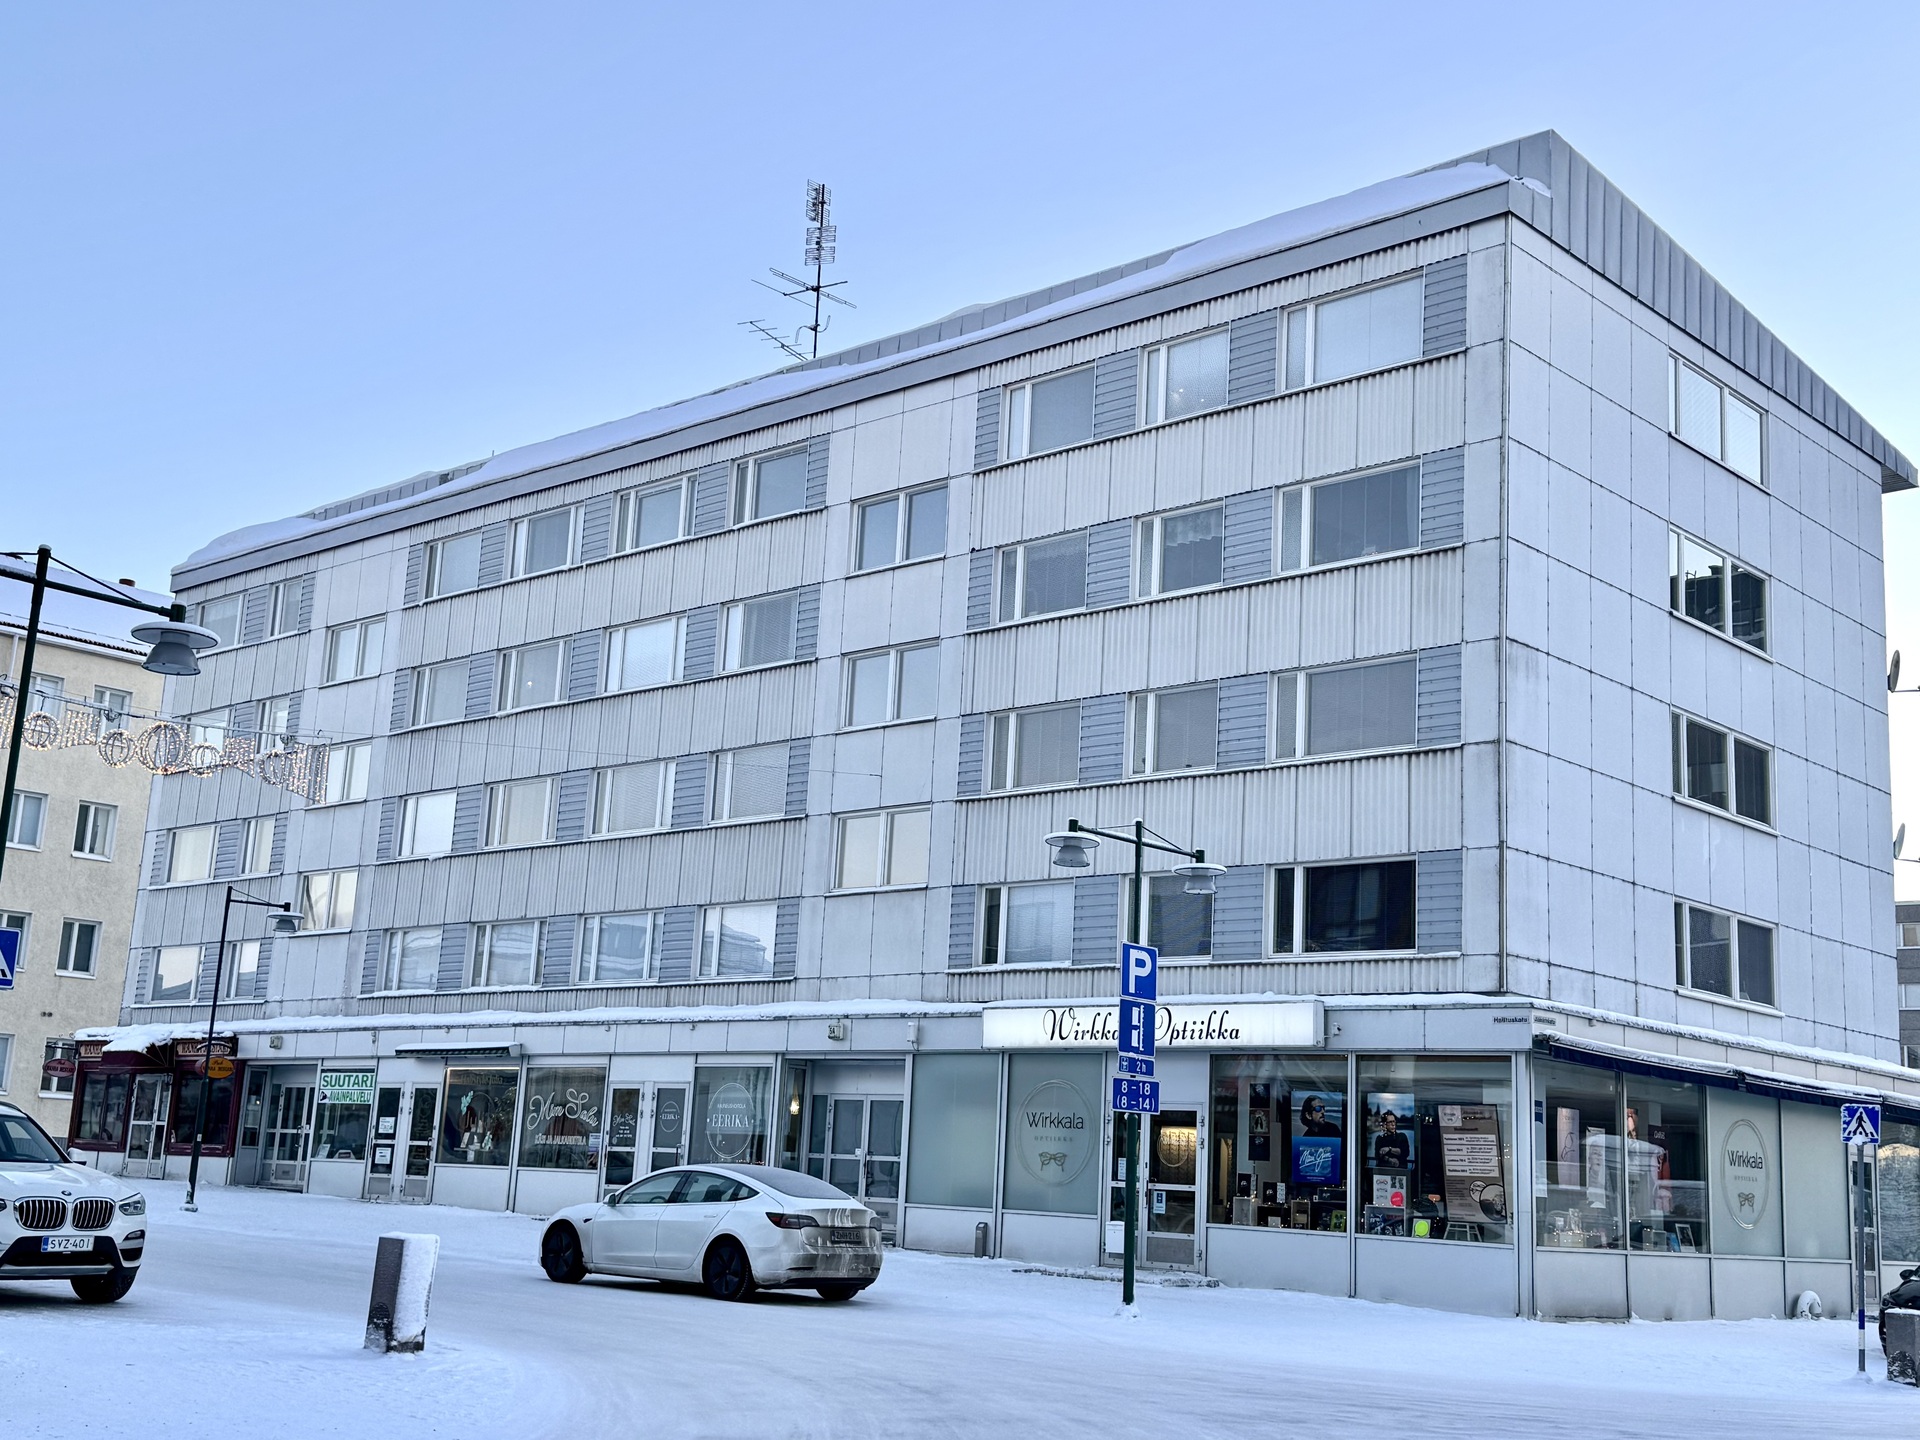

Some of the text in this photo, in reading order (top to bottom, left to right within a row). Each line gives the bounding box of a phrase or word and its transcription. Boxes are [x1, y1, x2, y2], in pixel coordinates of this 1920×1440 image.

[1128, 948, 1153, 994] P
[1043, 1007, 1240, 1046] Wirkk Optiikka
[322, 1074, 374, 1088] SUUTARI
[329, 1090, 372, 1103] AVAINPALVELU
[712, 1113, 749, 1128] EERIKA
[1026, 1111, 1084, 1130] Wirkkala
[1727, 1149, 1763, 1170] Wirkkala
